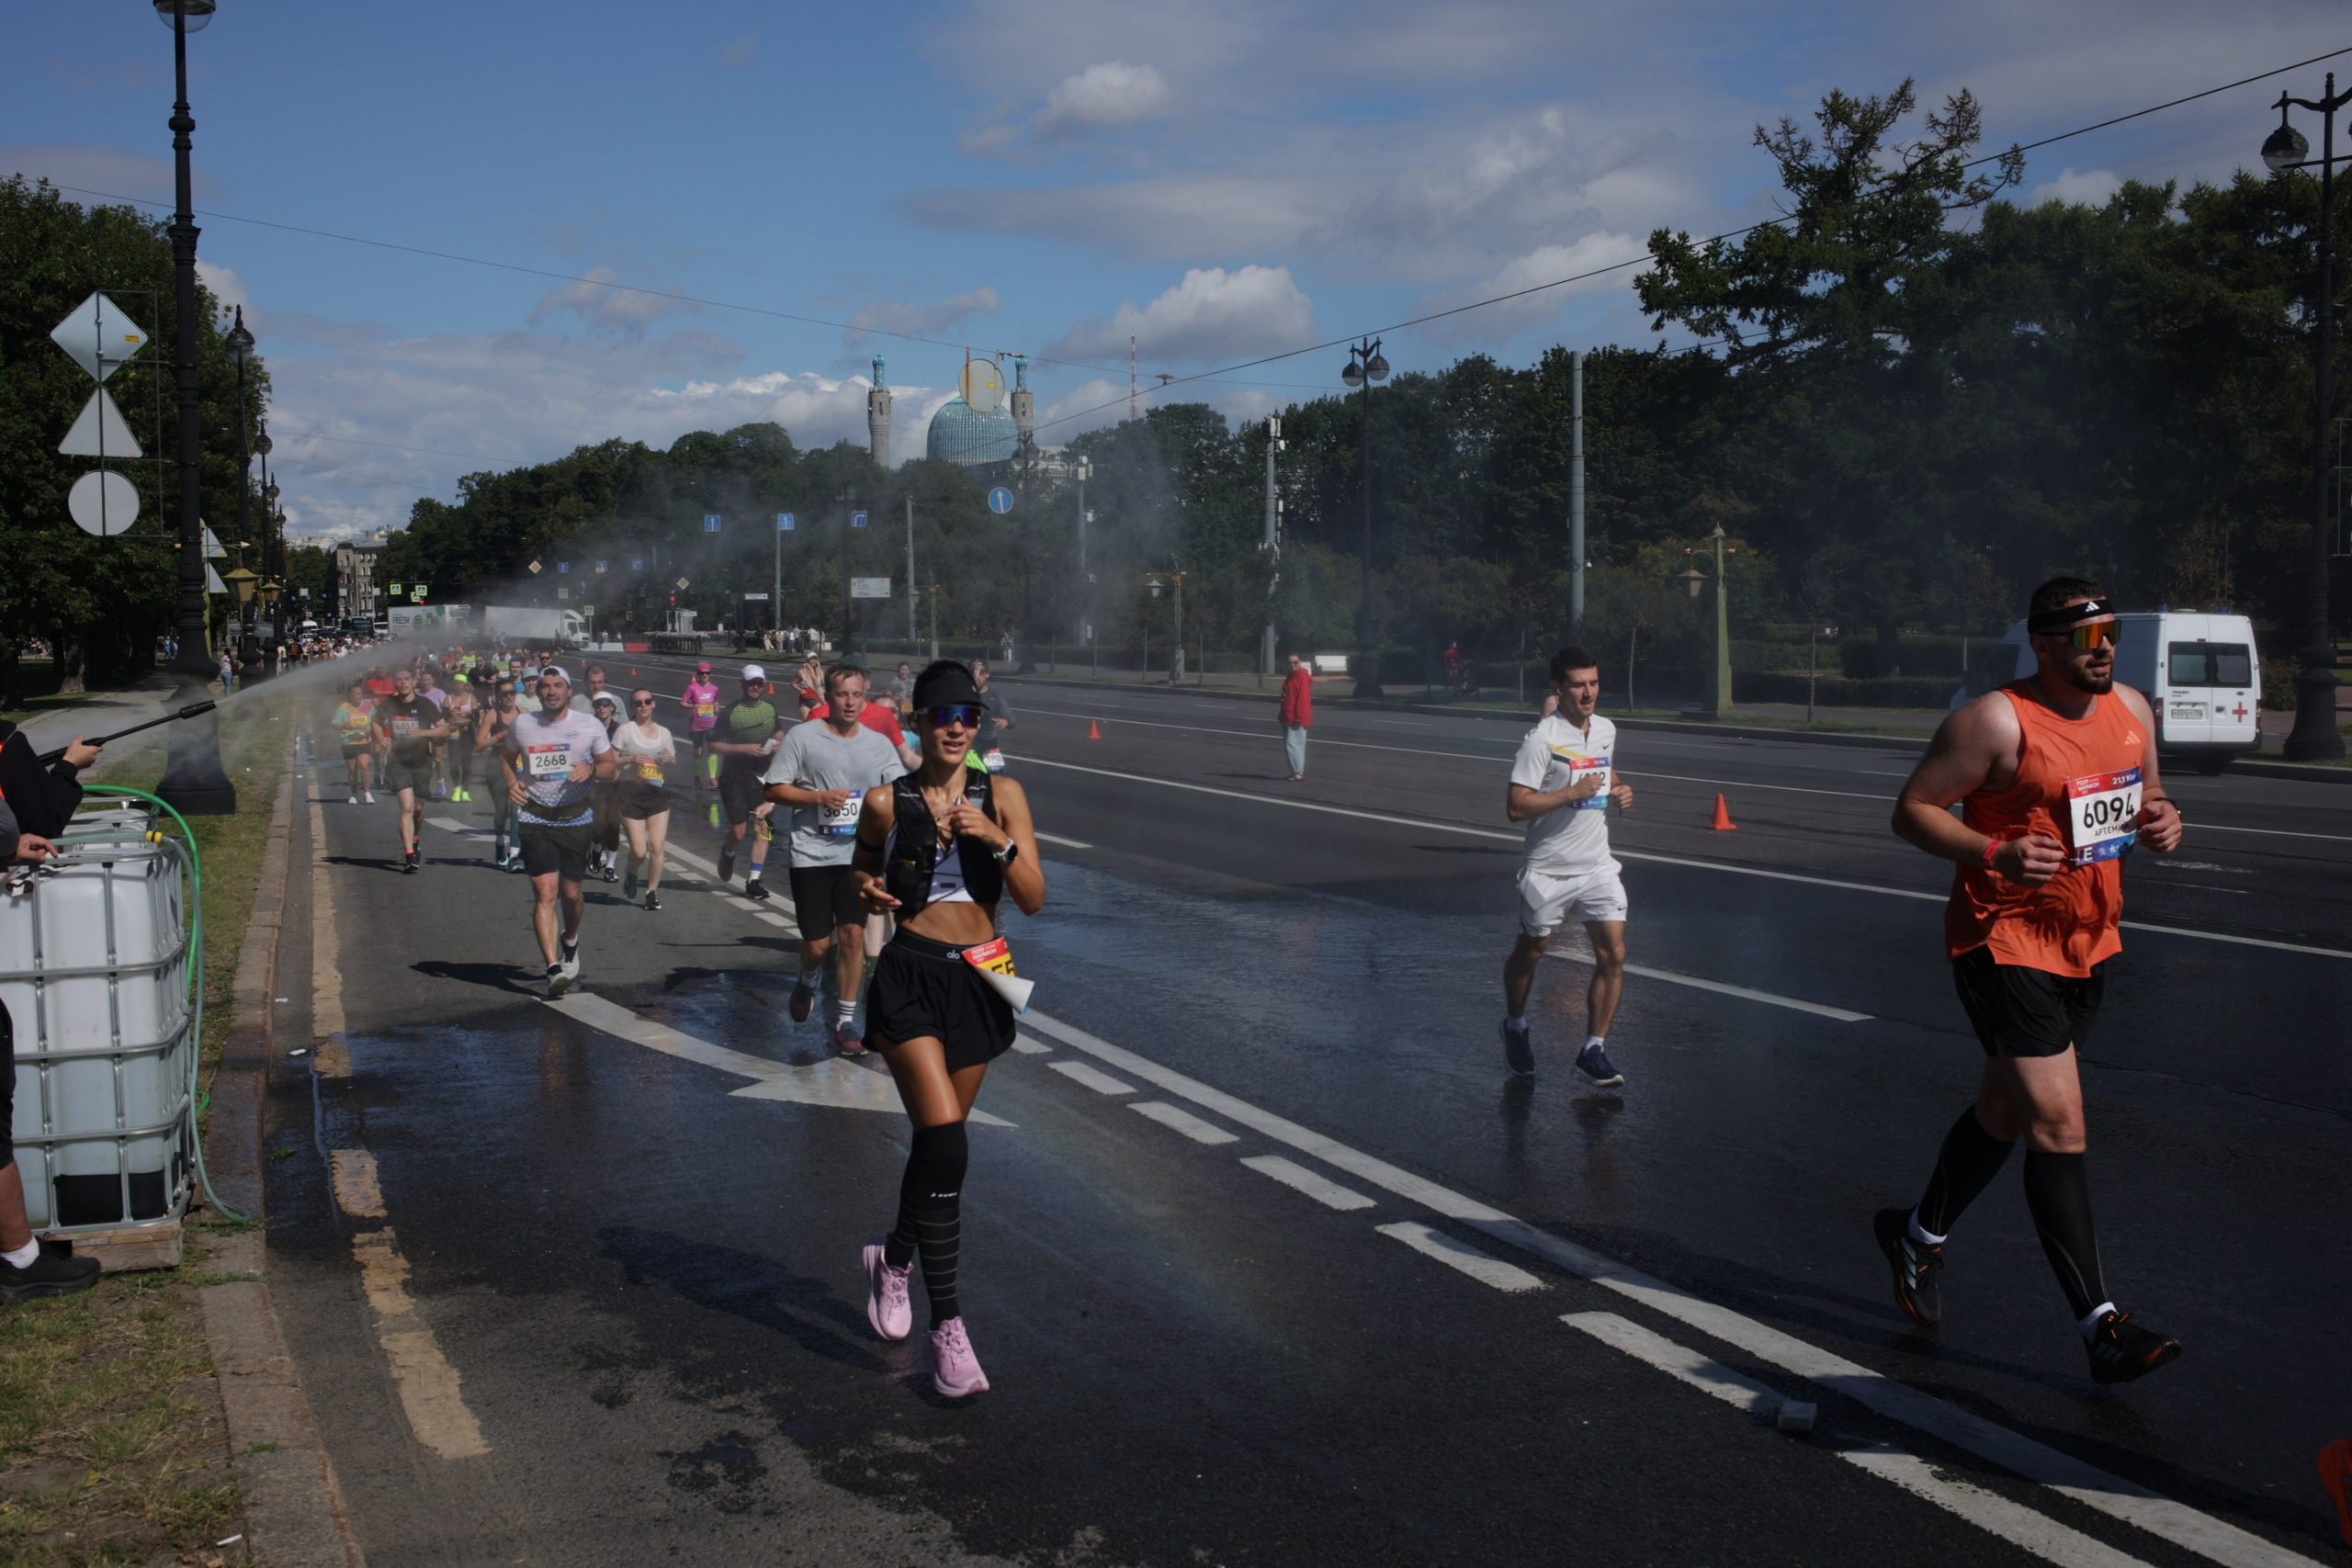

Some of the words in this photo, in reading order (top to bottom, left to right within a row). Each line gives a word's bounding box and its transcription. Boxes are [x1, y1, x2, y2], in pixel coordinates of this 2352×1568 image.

[535, 754, 567, 768] 2668
[2112, 775, 2126, 785] 21,1
[2083, 793, 2135, 829] 6094
[2083, 846, 2094, 862] E
[946, 949, 960, 960] alo
